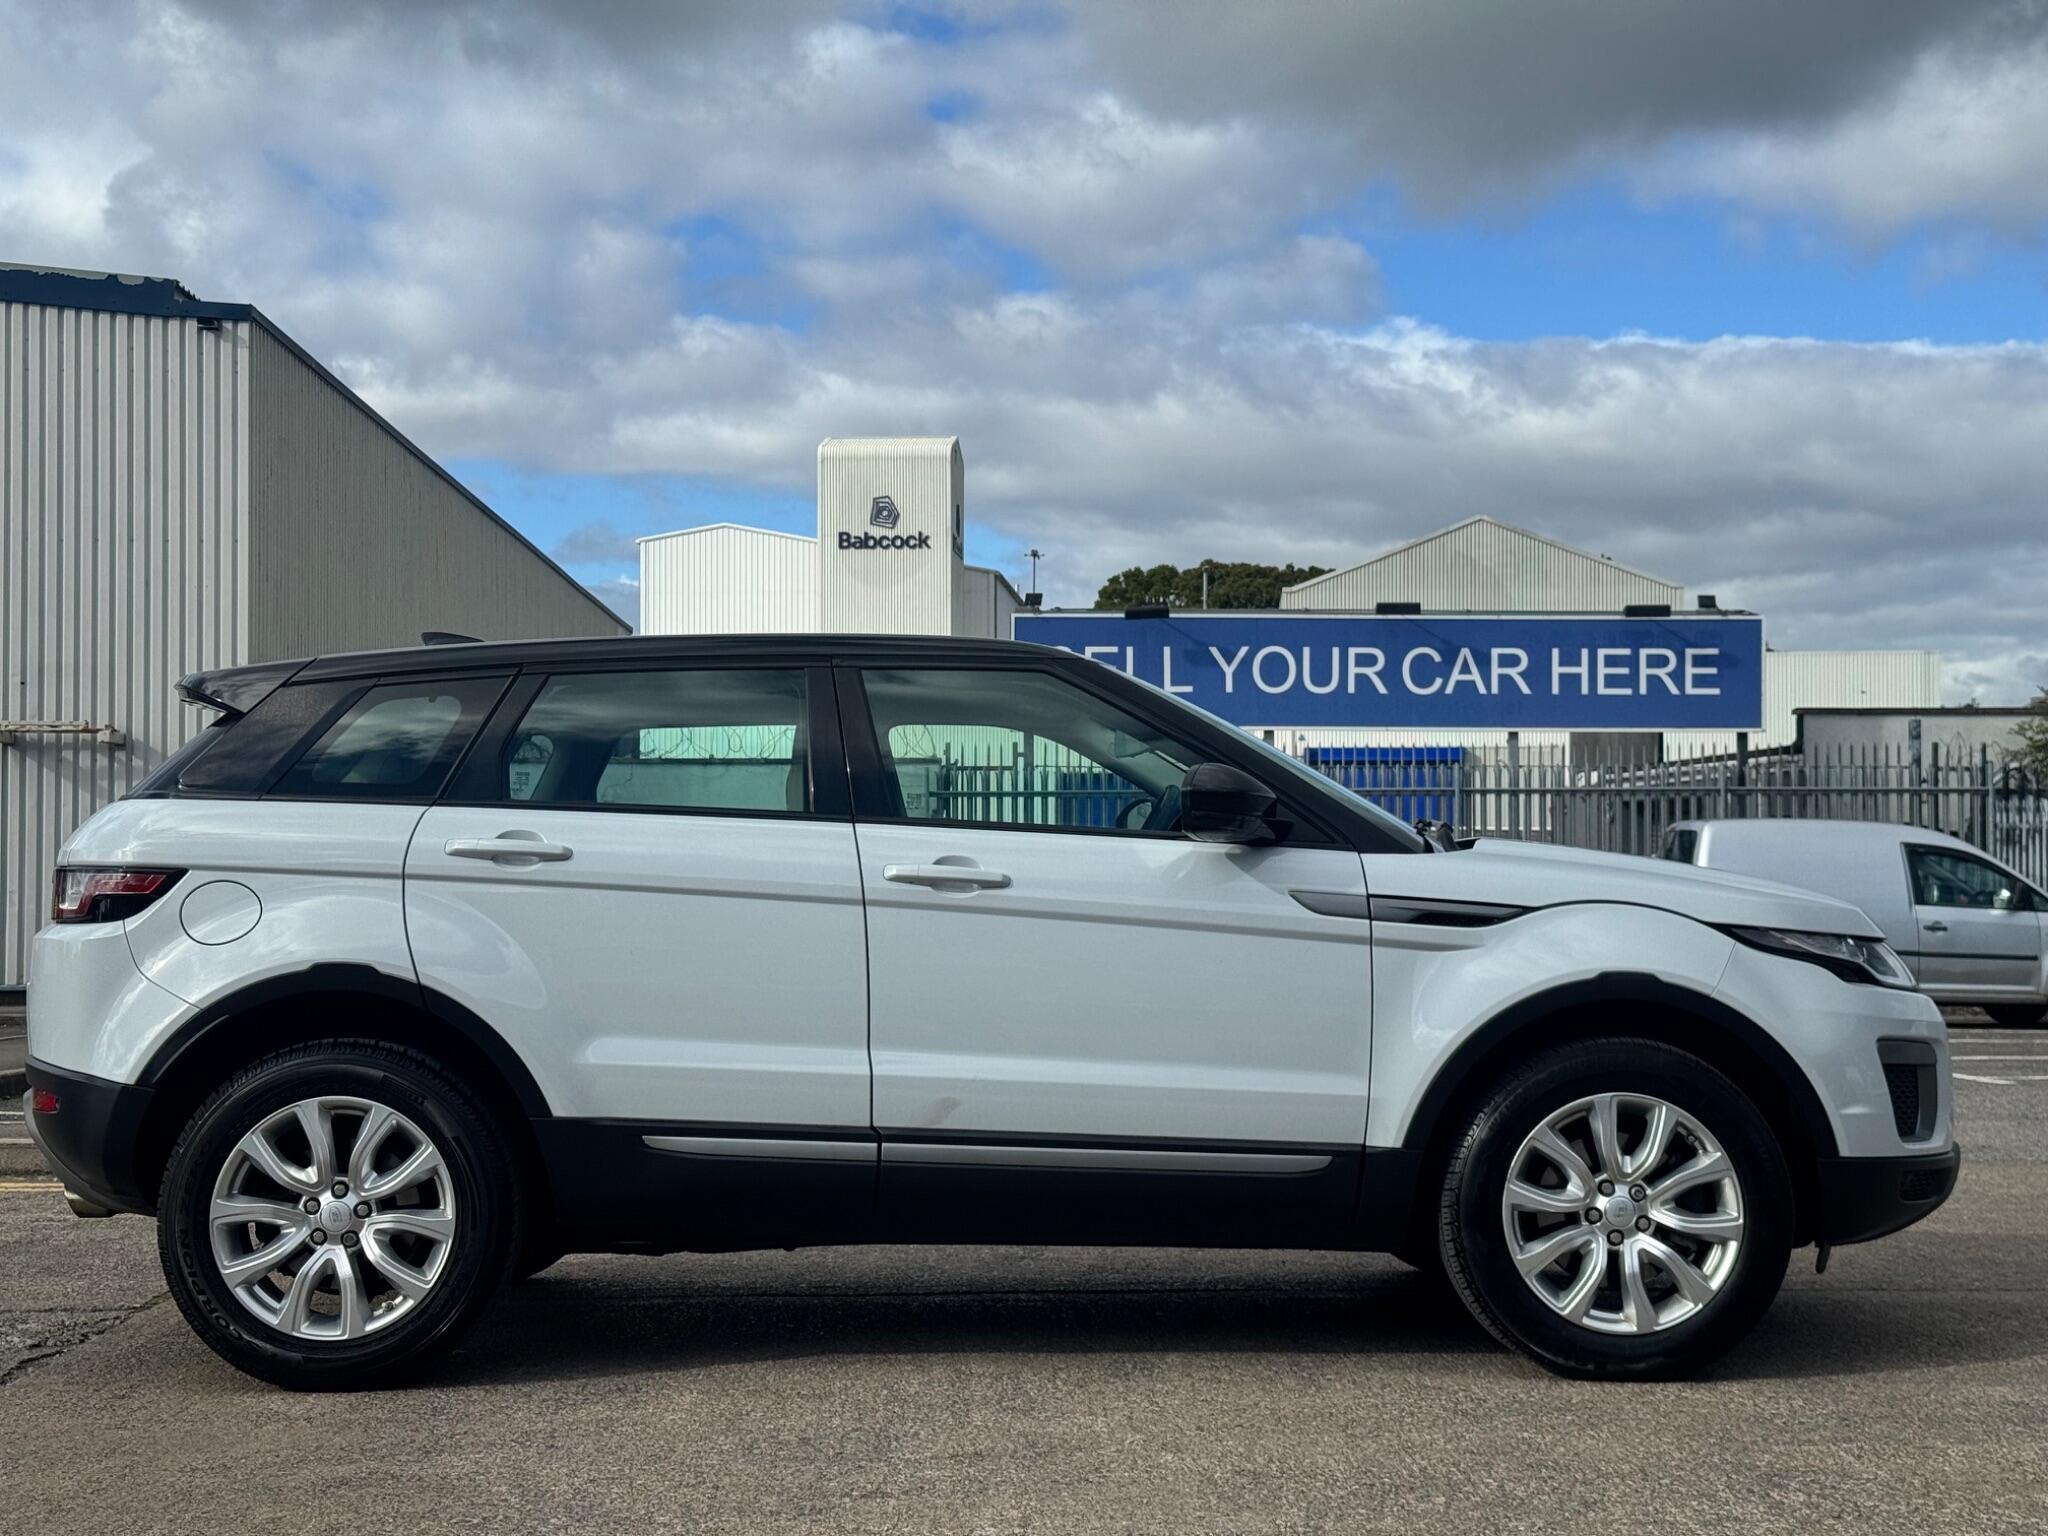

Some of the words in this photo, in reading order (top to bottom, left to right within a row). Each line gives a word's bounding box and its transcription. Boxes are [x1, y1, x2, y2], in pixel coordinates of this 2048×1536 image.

[838, 531, 931, 550] Babcock
[1209, 646, 1387, 694] YOUR
[1402, 646, 1531, 694] CAR
[1552, 648, 1720, 694] HERE
